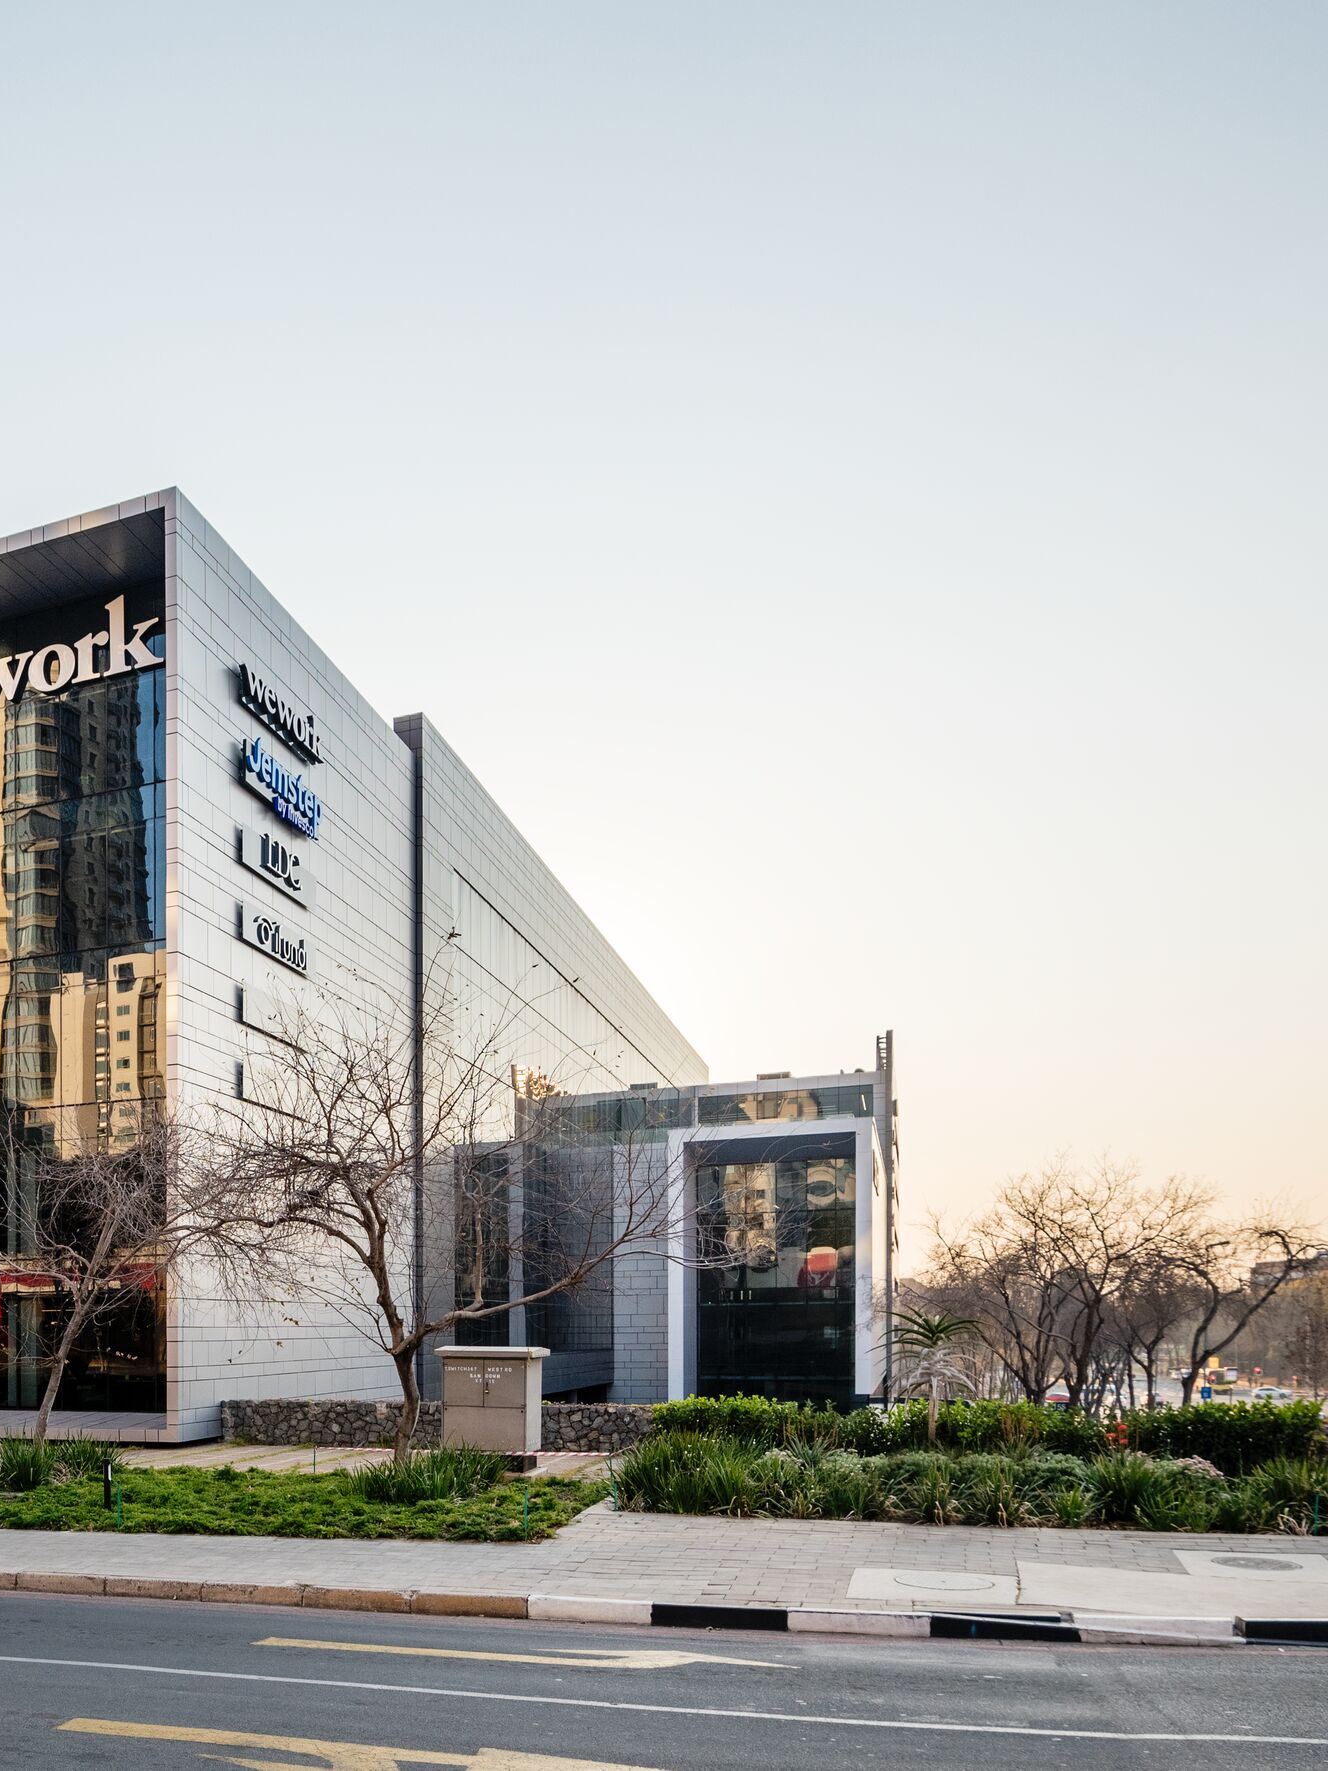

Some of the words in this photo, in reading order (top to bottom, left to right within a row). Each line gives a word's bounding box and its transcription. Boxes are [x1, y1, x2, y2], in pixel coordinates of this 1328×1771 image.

[240, 664, 324, 763] wework
[247, 737, 323, 839] Jemstep
[266, 833, 303, 890] LDC
